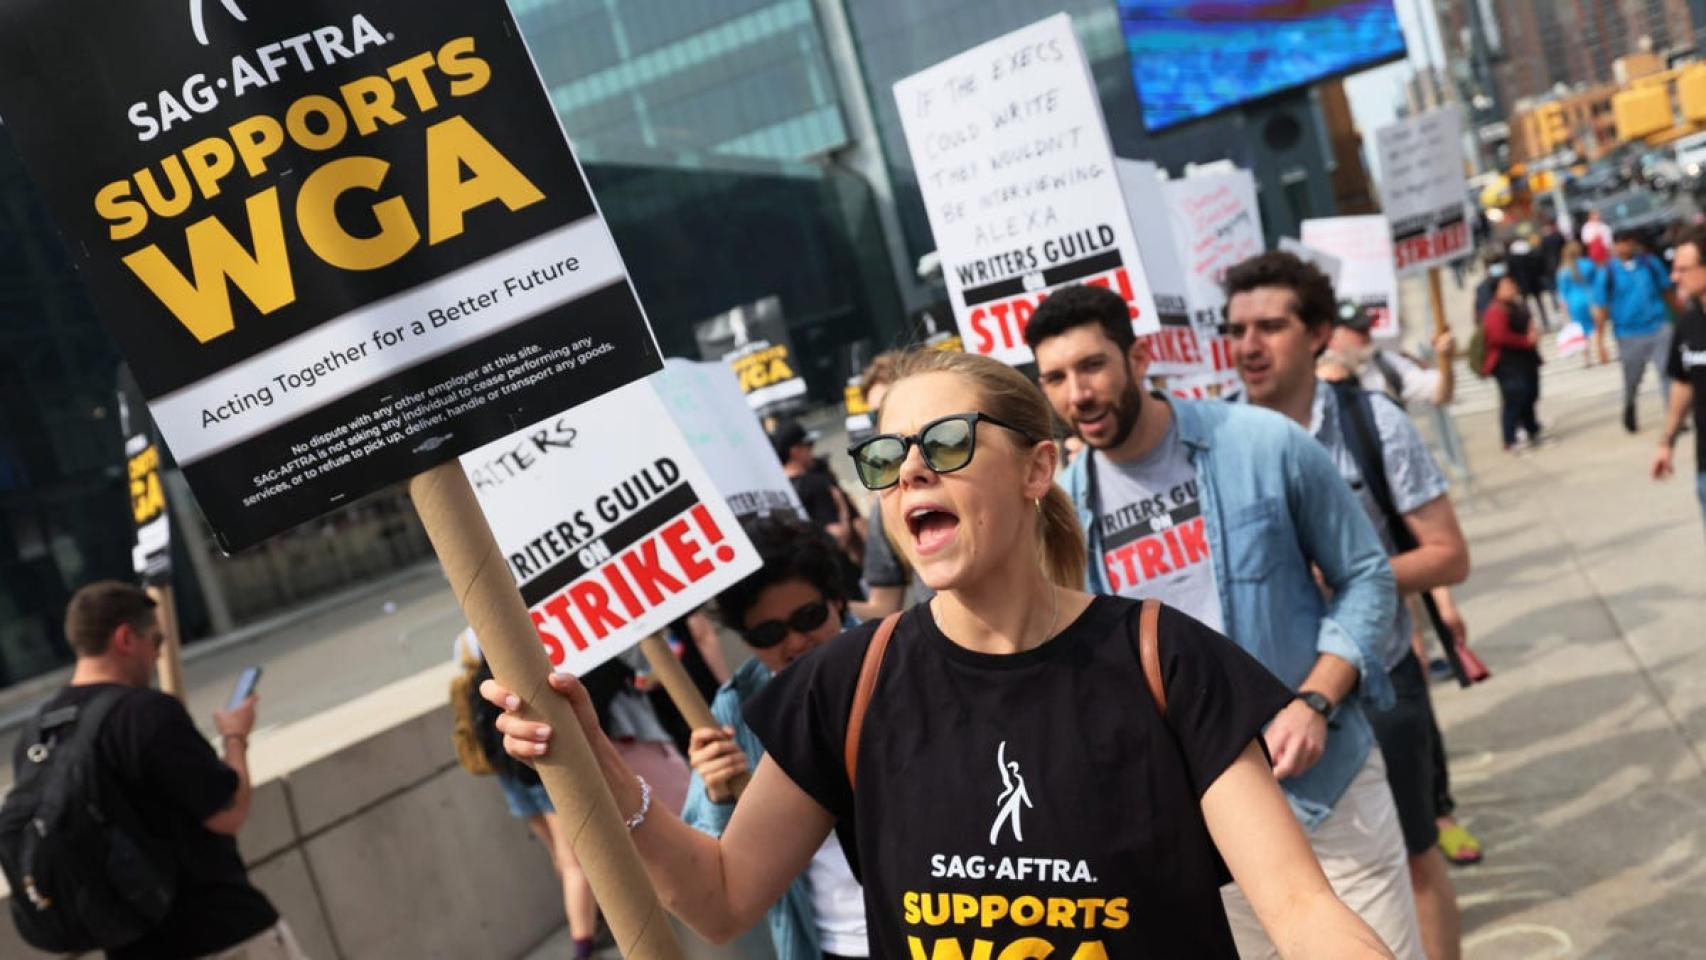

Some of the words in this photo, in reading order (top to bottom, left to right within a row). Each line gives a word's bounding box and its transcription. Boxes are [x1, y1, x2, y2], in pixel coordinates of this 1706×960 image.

[915, 88, 932, 119] IF
[945, 74, 977, 101] THE
[991, 39, 1064, 81] EXECS
[993, 88, 1059, 129] WRITE
[94, 36, 492, 241] SUPPORTS
[121, 114, 547, 344] WGA
[942, 202, 965, 224] BE
[975, 205, 1058, 246] ALEXA
[955, 245, 1038, 286] WRITERS
[1044, 224, 1115, 263] GUILD
[201, 386, 274, 429] Acting
[272, 342, 368, 393] Together
[372, 327, 405, 350] for
[410, 320, 426, 335] a
[427, 289, 499, 328] Better
[503, 256, 580, 297] Future
[970, 266, 1140, 355] STR!
[242, 481, 292, 507] services,
[290, 474, 304, 486] or
[304, 468, 318, 480] to
[318, 453, 352, 474] refuse
[351, 448, 364, 459] to
[363, 438, 386, 456] pick
[386, 431, 406, 445] up,
[404, 412, 448, 436] deliver,
[446, 395, 487, 417] handle
[487, 389, 500, 401] or
[500, 366, 554, 395] transport
[555, 357, 576, 373] any
[577, 341, 615, 366] goods.
[252, 453, 318, 488] SAG-AFTRA
[316, 448, 328, 460] is
[328, 440, 347, 456] not
[347, 425, 381, 446] asking
[380, 416, 401, 432] any
[401, 390, 458, 422] individual
[458, 386, 473, 398] to
[472, 372, 506, 392] cease
[506, 345, 570, 380] performing
[571, 336, 592, 351] any
[291, 443, 309, 456] No
[309, 424, 348, 448] dispute
[348, 414, 372, 430] with
[372, 404, 393, 421] any
[394, 390, 426, 411] other
[427, 368, 479, 396] employer
[481, 362, 495, 375] at
[494, 353, 518, 368] this
[518, 344, 543, 359] site.
[472, 418, 578, 489] RITERS
[508, 510, 594, 579] RITERS
[595, 457, 681, 524] GUILD
[578, 538, 611, 569] ON
[1103, 493, 1167, 534] RITERS
[529, 502, 736, 667] STRIKE!
[1104, 515, 1210, 593] STRIK
[903, 891, 1130, 930] SUPPORTS
